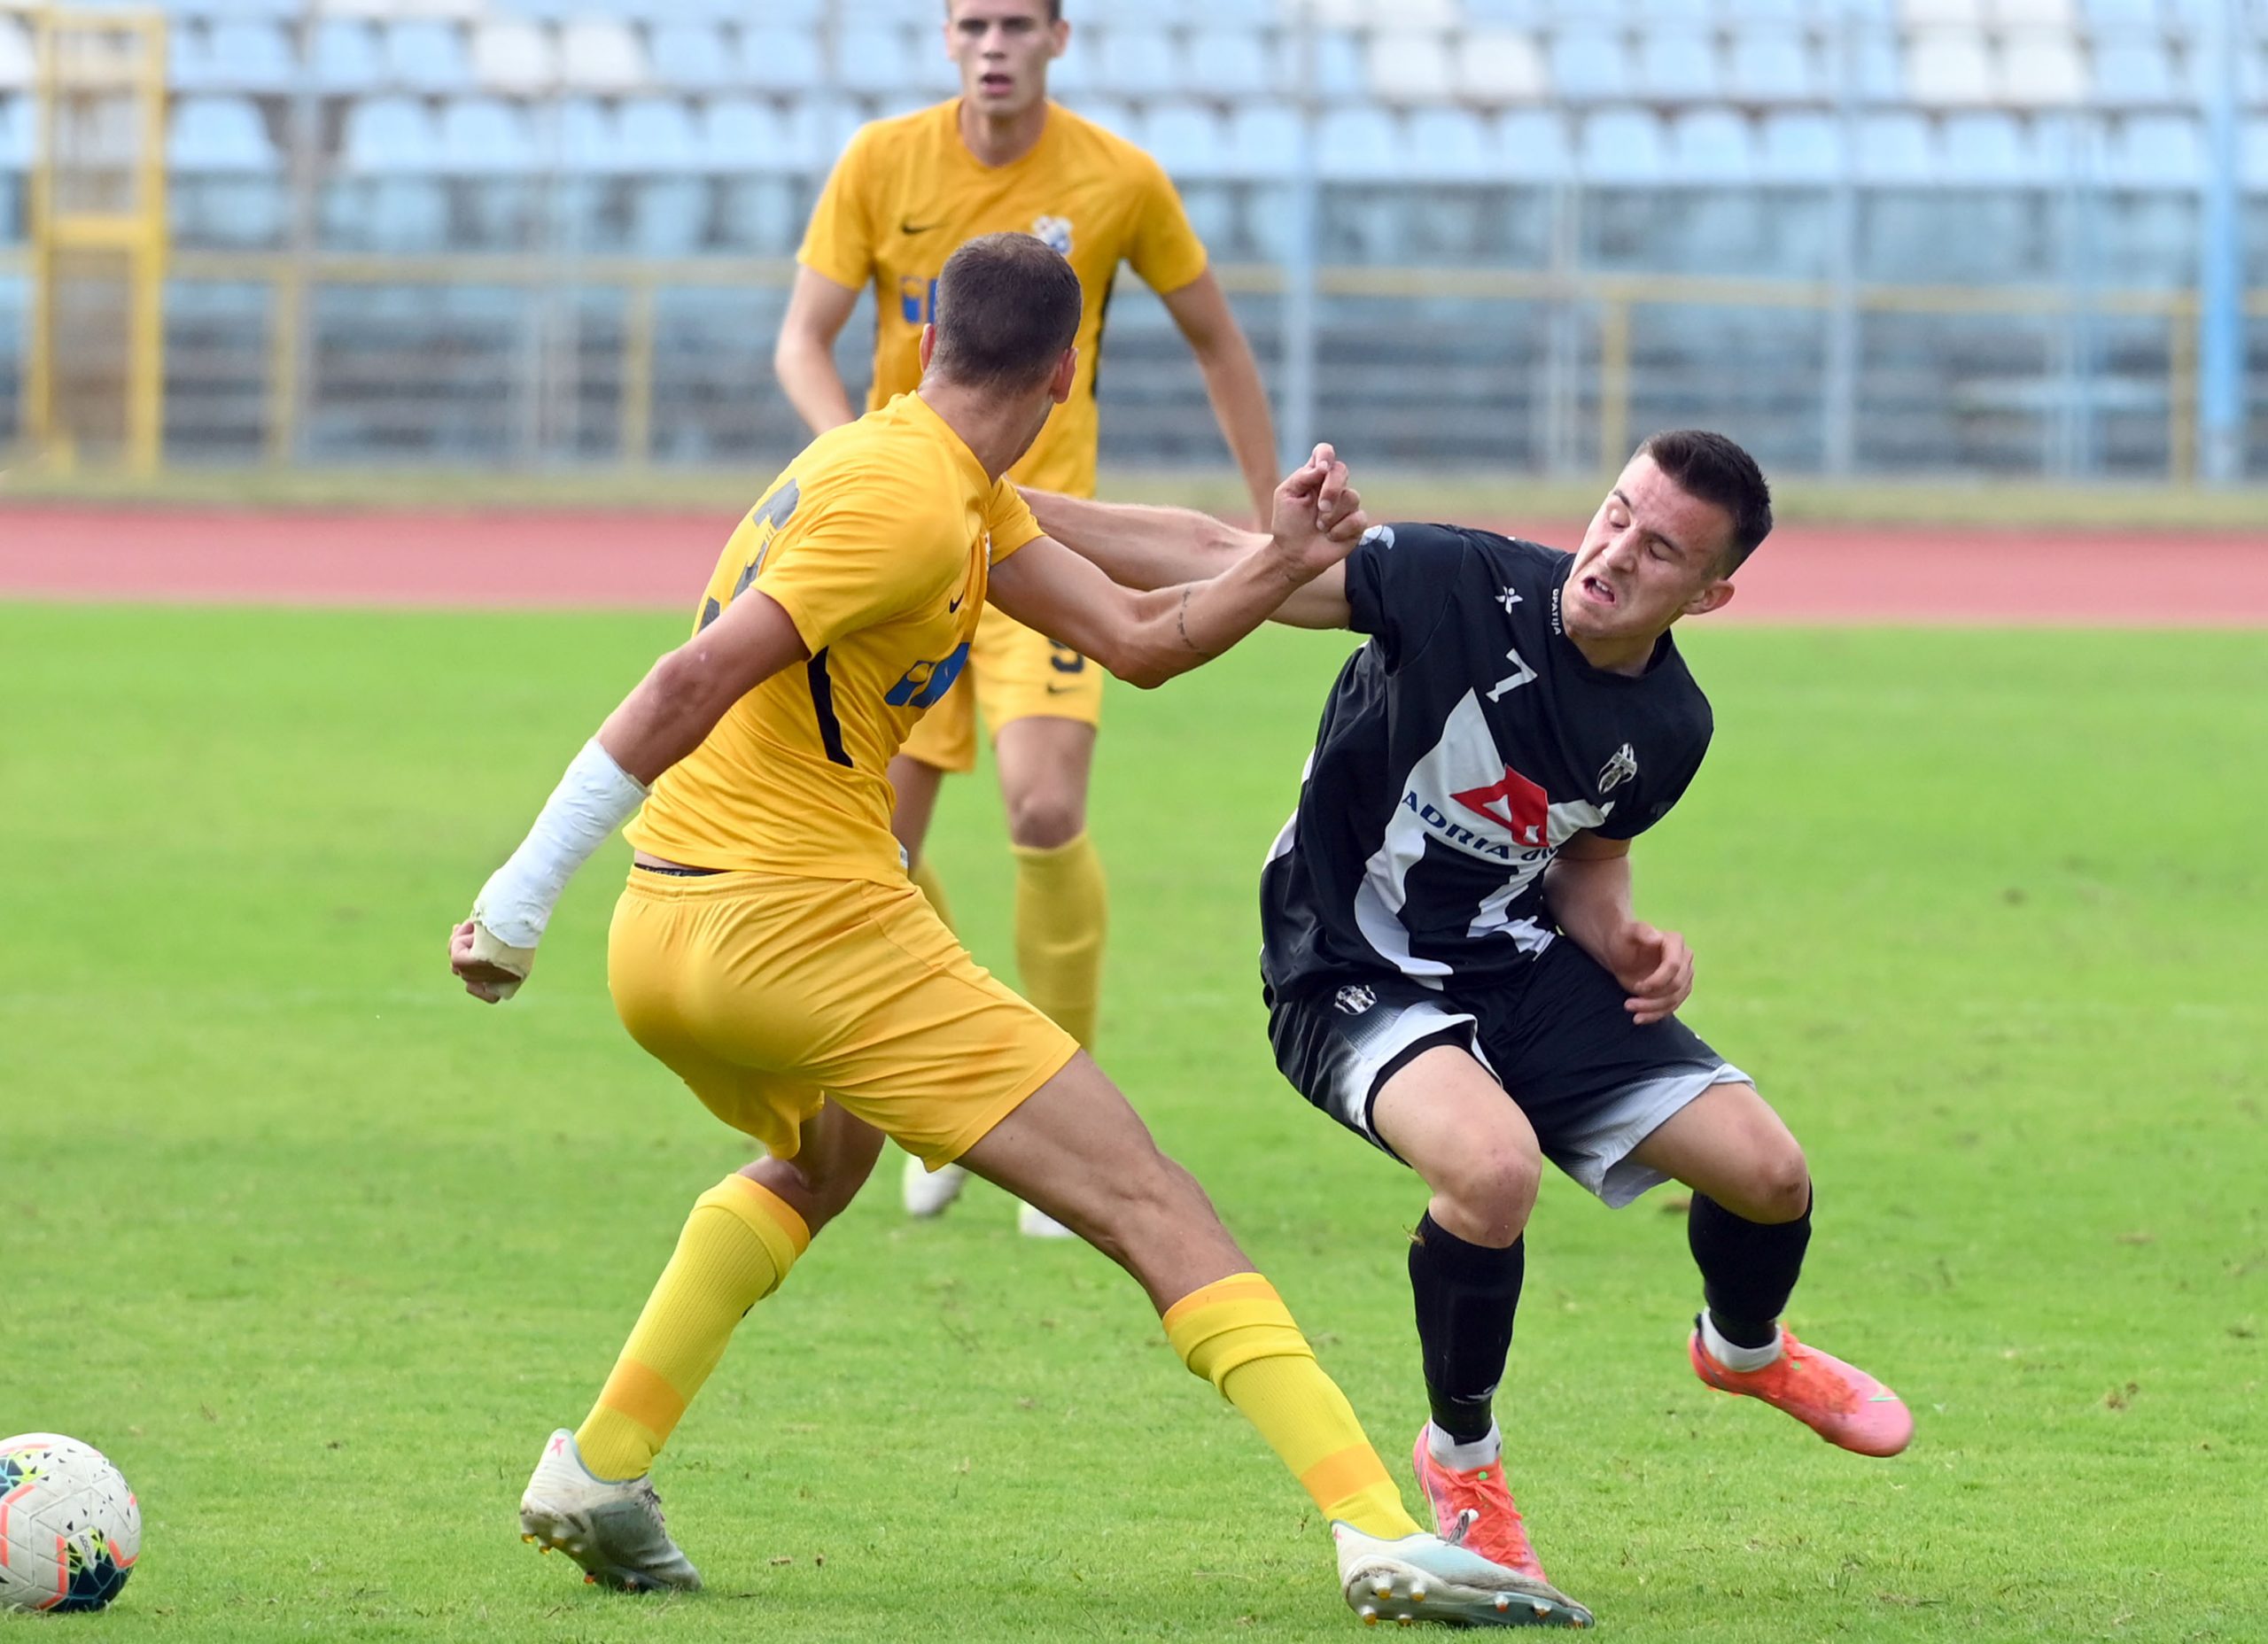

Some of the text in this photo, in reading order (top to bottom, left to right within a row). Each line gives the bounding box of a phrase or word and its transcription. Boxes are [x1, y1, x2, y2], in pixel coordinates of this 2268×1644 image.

[1551, 588, 1562, 635] OPATIJA
[1486, 648, 1538, 702] 7
[1402, 790, 1510, 859] ADRIA
